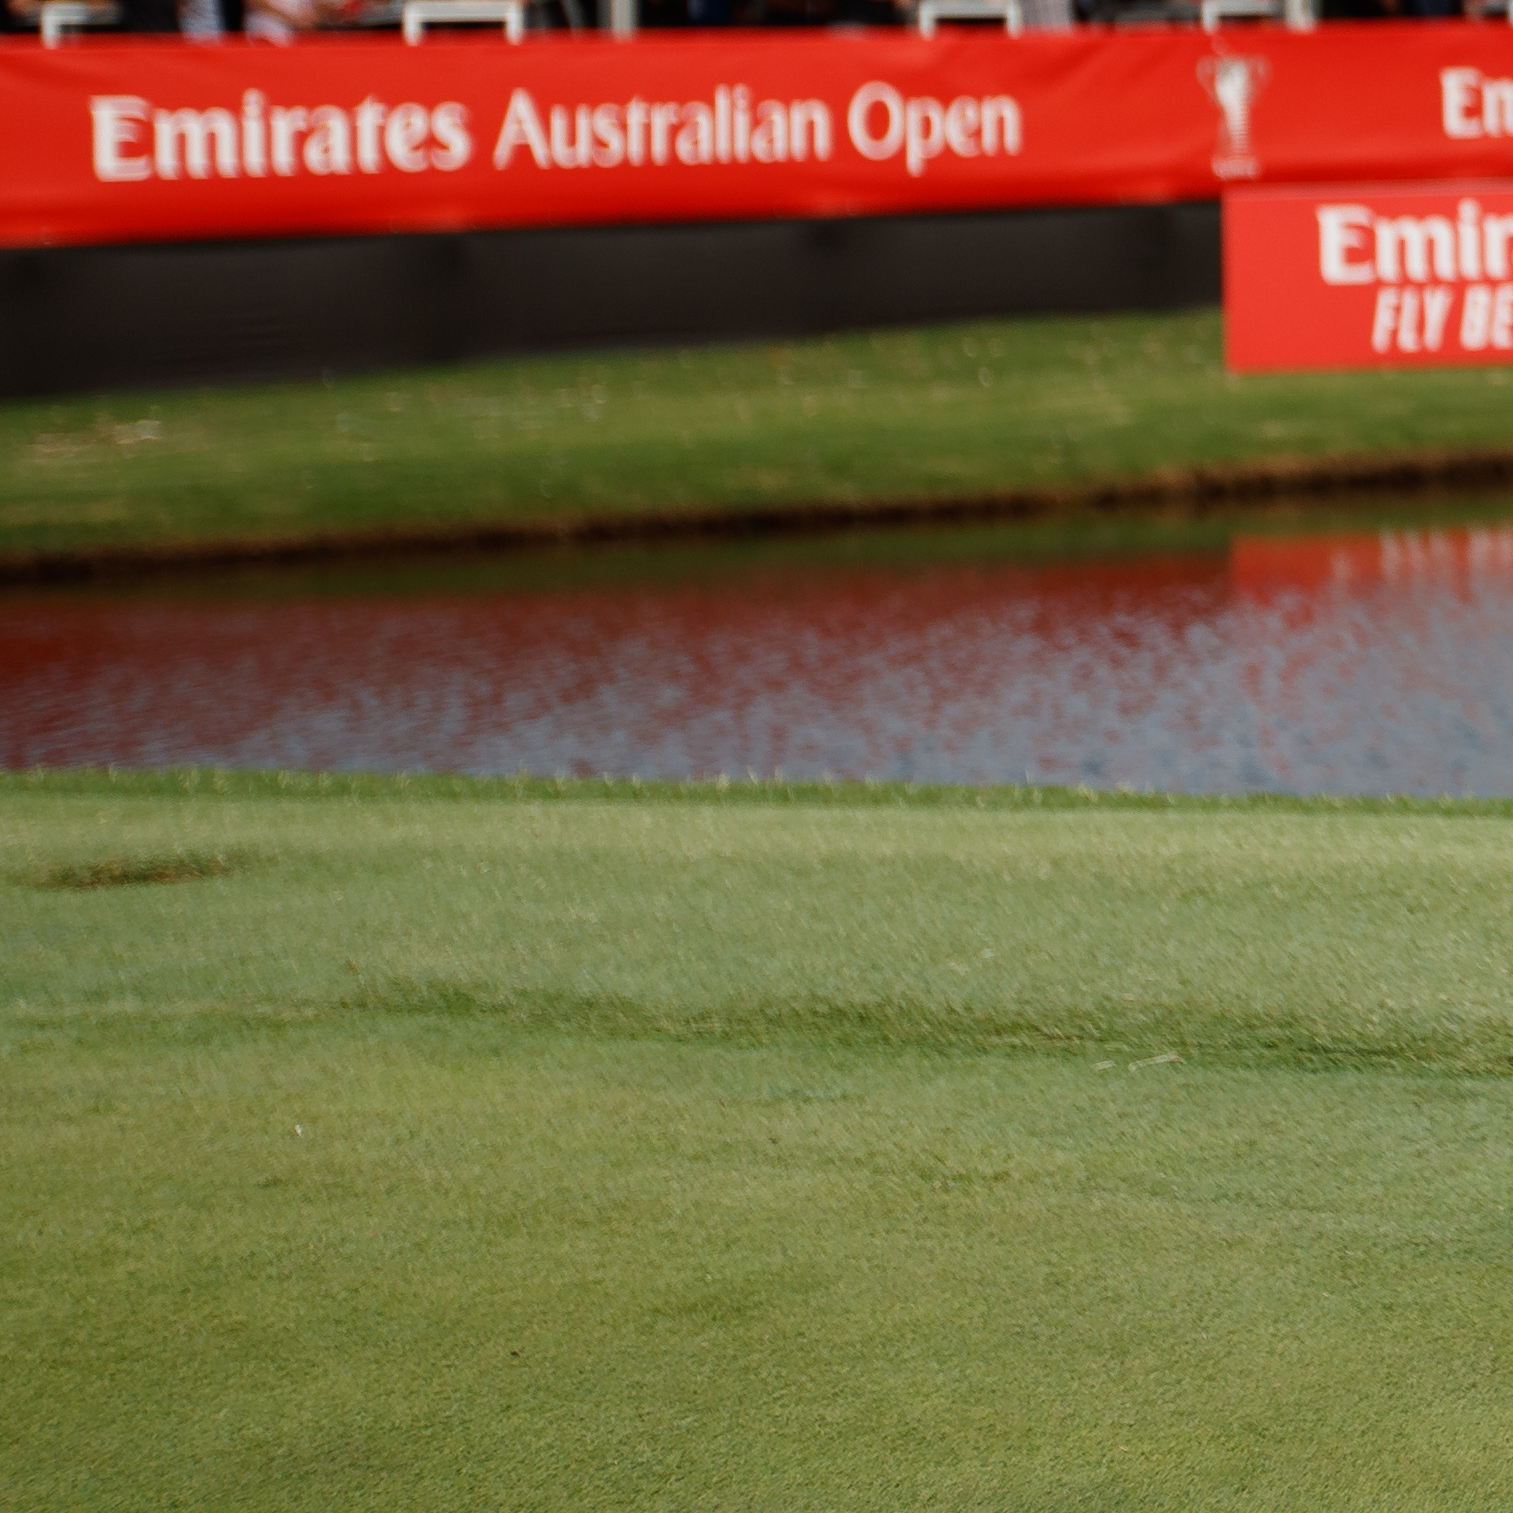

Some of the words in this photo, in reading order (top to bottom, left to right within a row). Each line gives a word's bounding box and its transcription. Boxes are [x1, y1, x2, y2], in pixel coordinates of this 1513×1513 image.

[90, 87, 473, 183] Emirates
[492, 83, 836, 172] Australian
[847, 80, 1024, 176] Open
[1371, 283, 1455, 354] FLY
